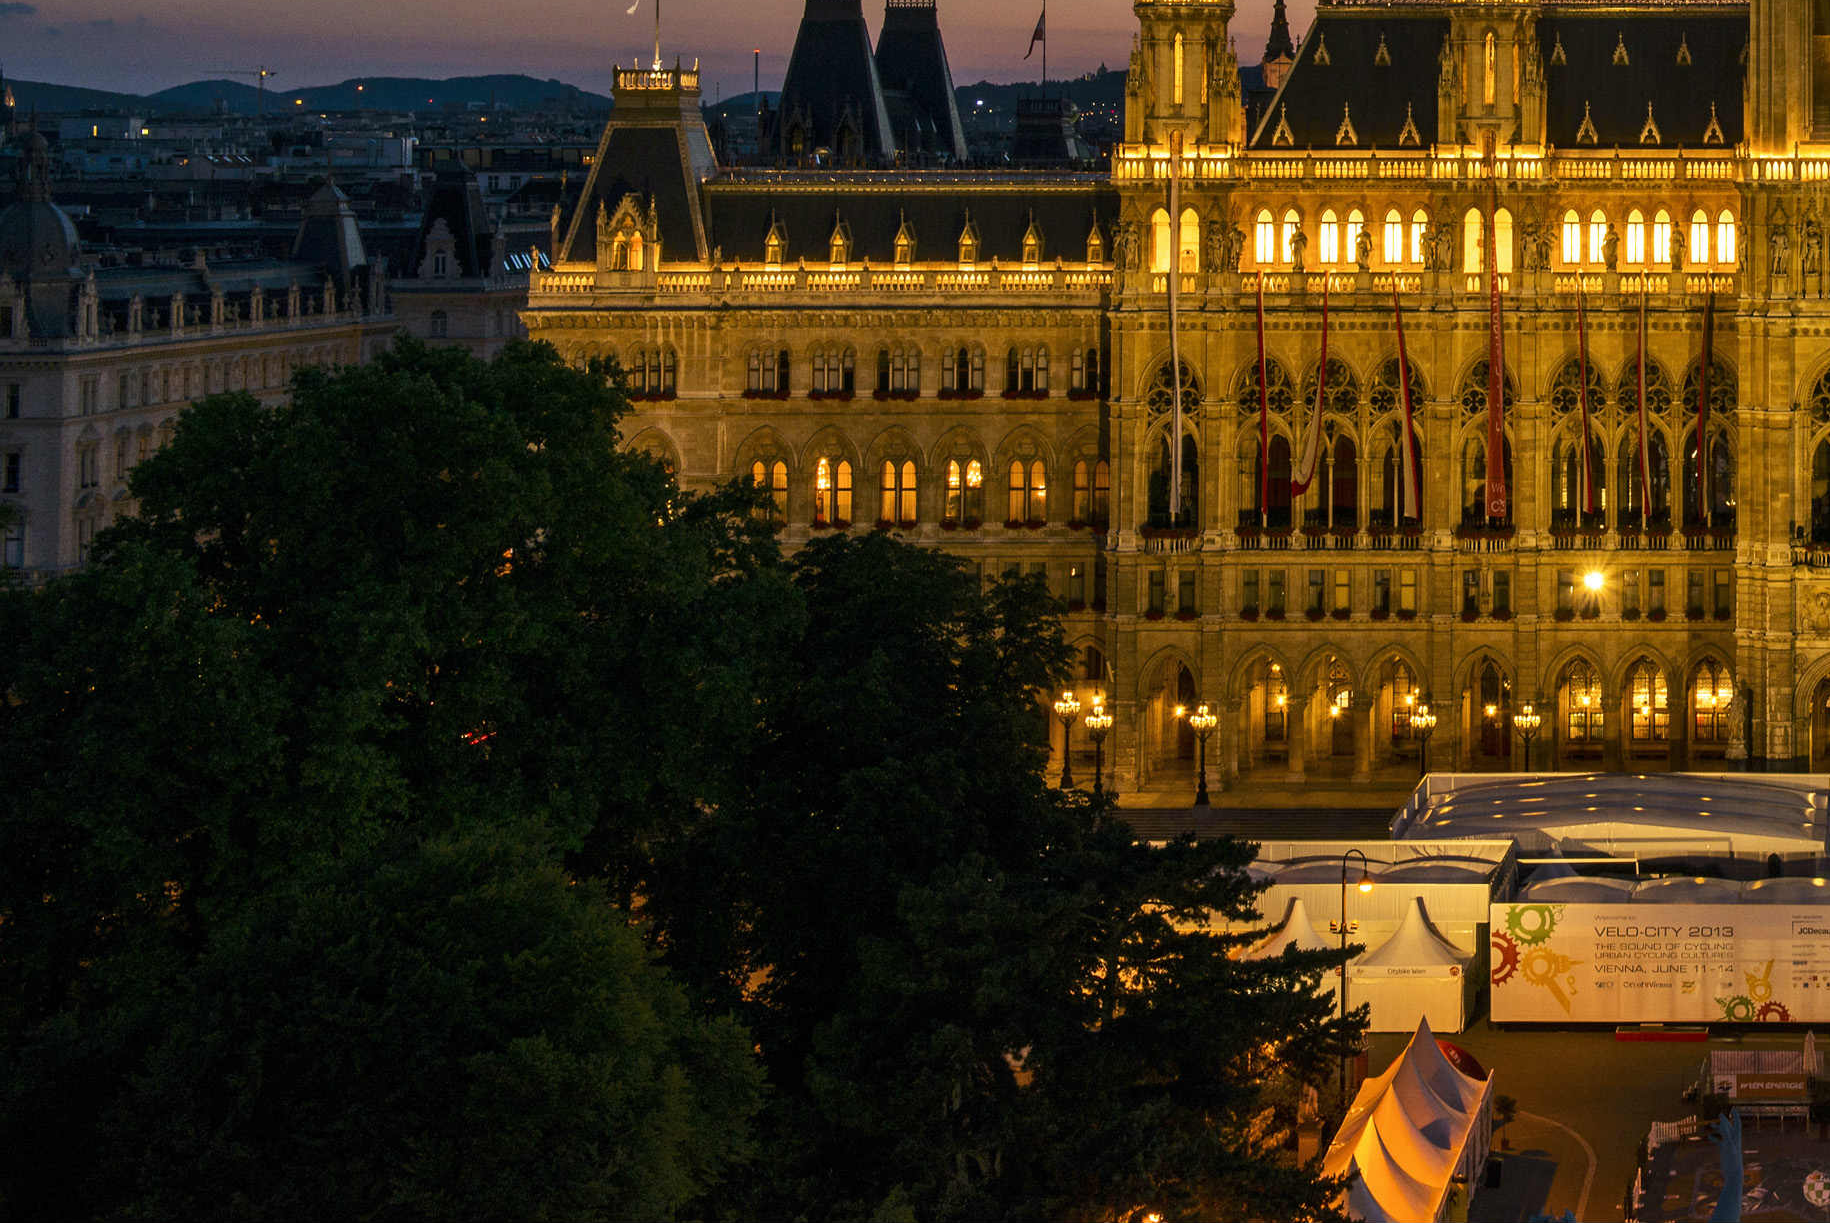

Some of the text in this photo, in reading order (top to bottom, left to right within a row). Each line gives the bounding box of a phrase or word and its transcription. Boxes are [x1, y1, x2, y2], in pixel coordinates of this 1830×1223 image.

[1594, 926, 1734, 938] VELO-CITY 2013
[1594, 942, 1734, 951] THE SOUND OF CYCLING
[1594, 951, 1734, 960] URBAN CYCLING CULTURES
[1594, 964, 1647, 974] VIENNA,
[1652, 964, 1687, 973] JUNE
